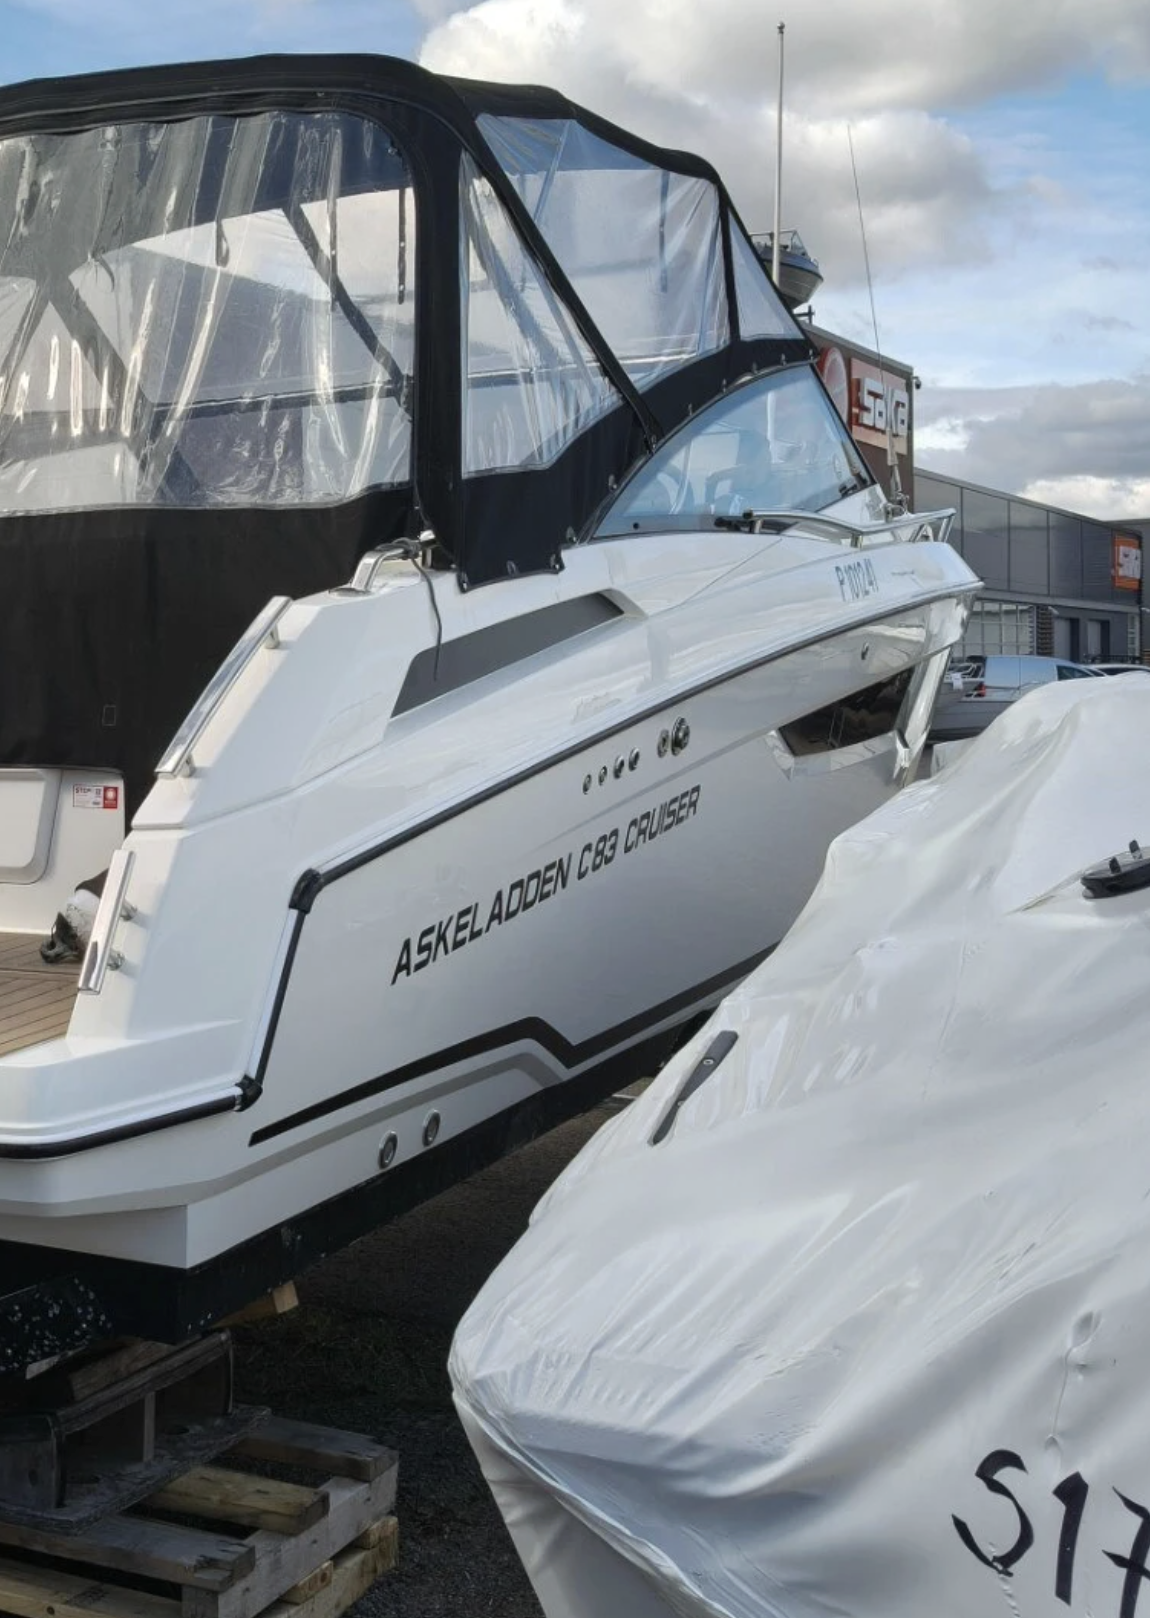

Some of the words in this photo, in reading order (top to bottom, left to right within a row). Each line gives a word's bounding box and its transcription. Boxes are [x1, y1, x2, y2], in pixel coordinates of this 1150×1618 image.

[391, 853, 573, 986] ASKELADDEN
[577, 828, 619, 881] C83
[624, 784, 701, 854] CRUISER
